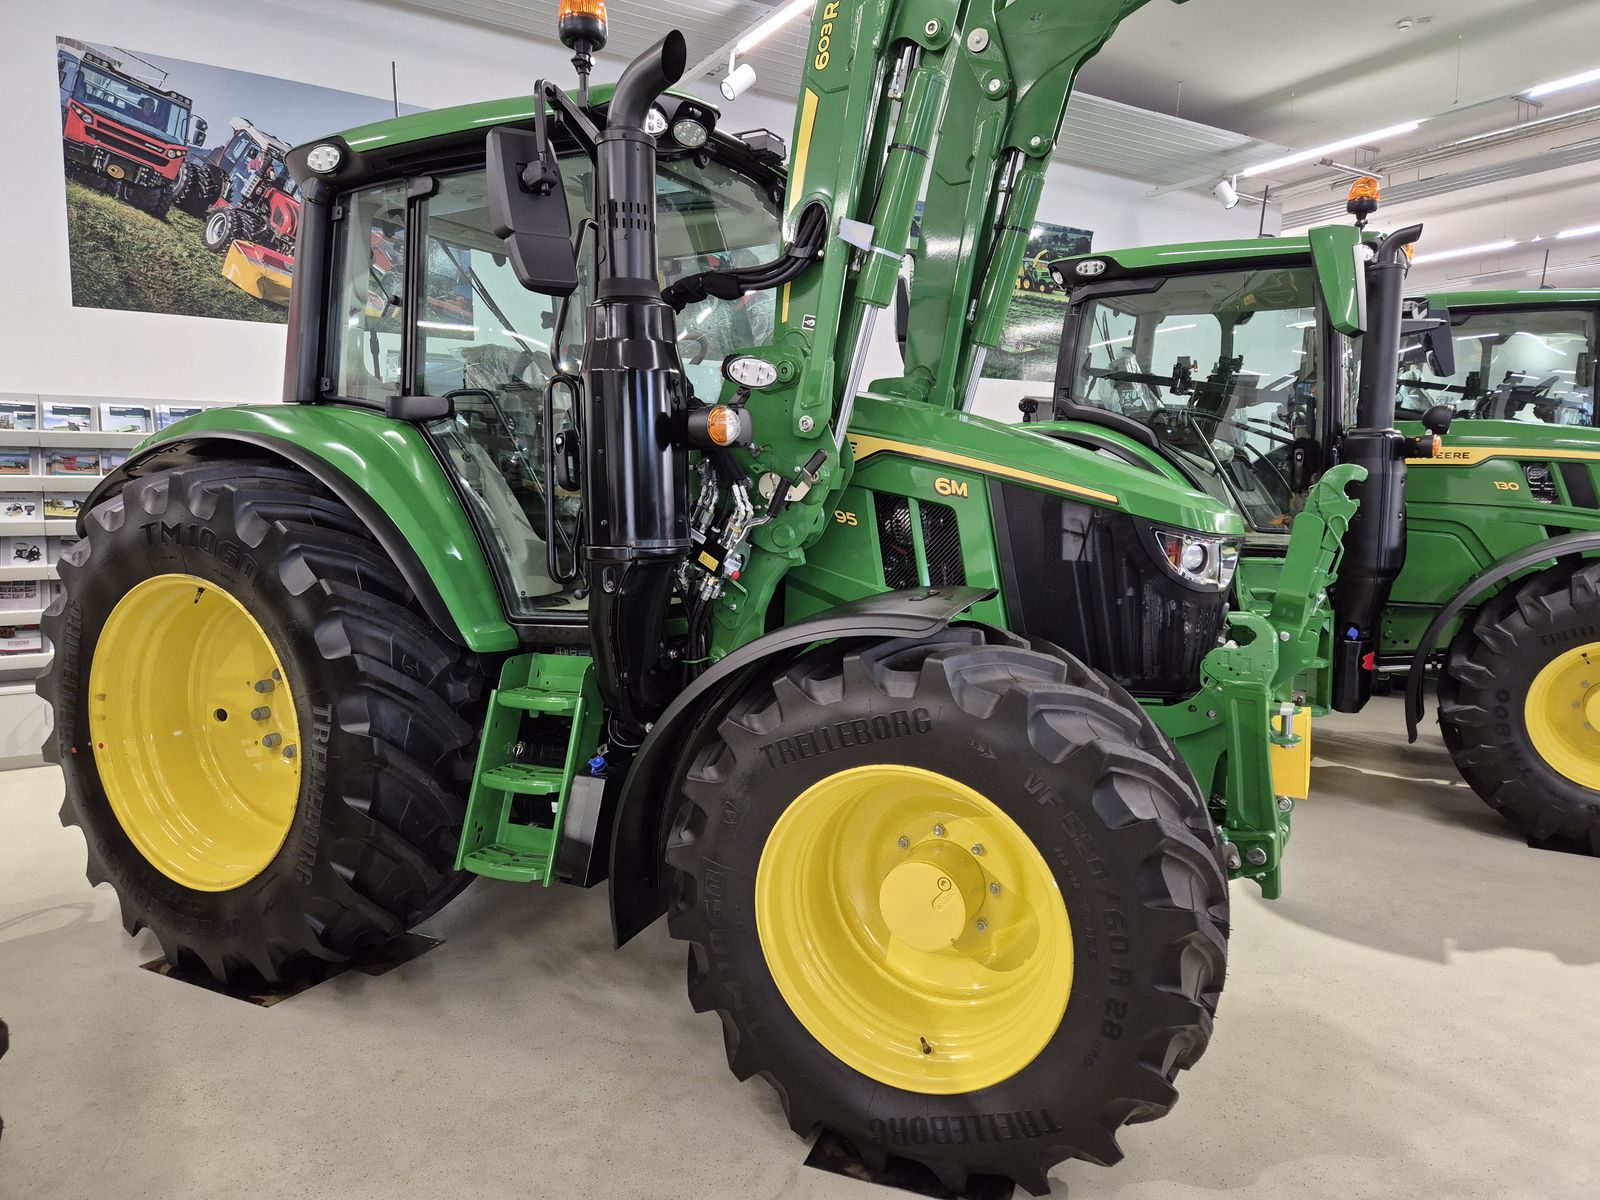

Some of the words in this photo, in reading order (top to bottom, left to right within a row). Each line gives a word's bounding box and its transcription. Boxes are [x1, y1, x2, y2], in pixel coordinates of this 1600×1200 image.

[1435, 451, 1470, 460] EERE
[934, 476, 969, 498] 6M
[1493, 481, 1520, 491] 130
[834, 509, 858, 526] 95
[139, 519, 261, 588] TM1060
[758, 706, 933, 771] TRELLEBORG
[296, 702, 333, 888] TRELLEBORG
[1023, 768, 1059, 809] VF
[867, 1106, 1064, 1146] TRELLEBORG
